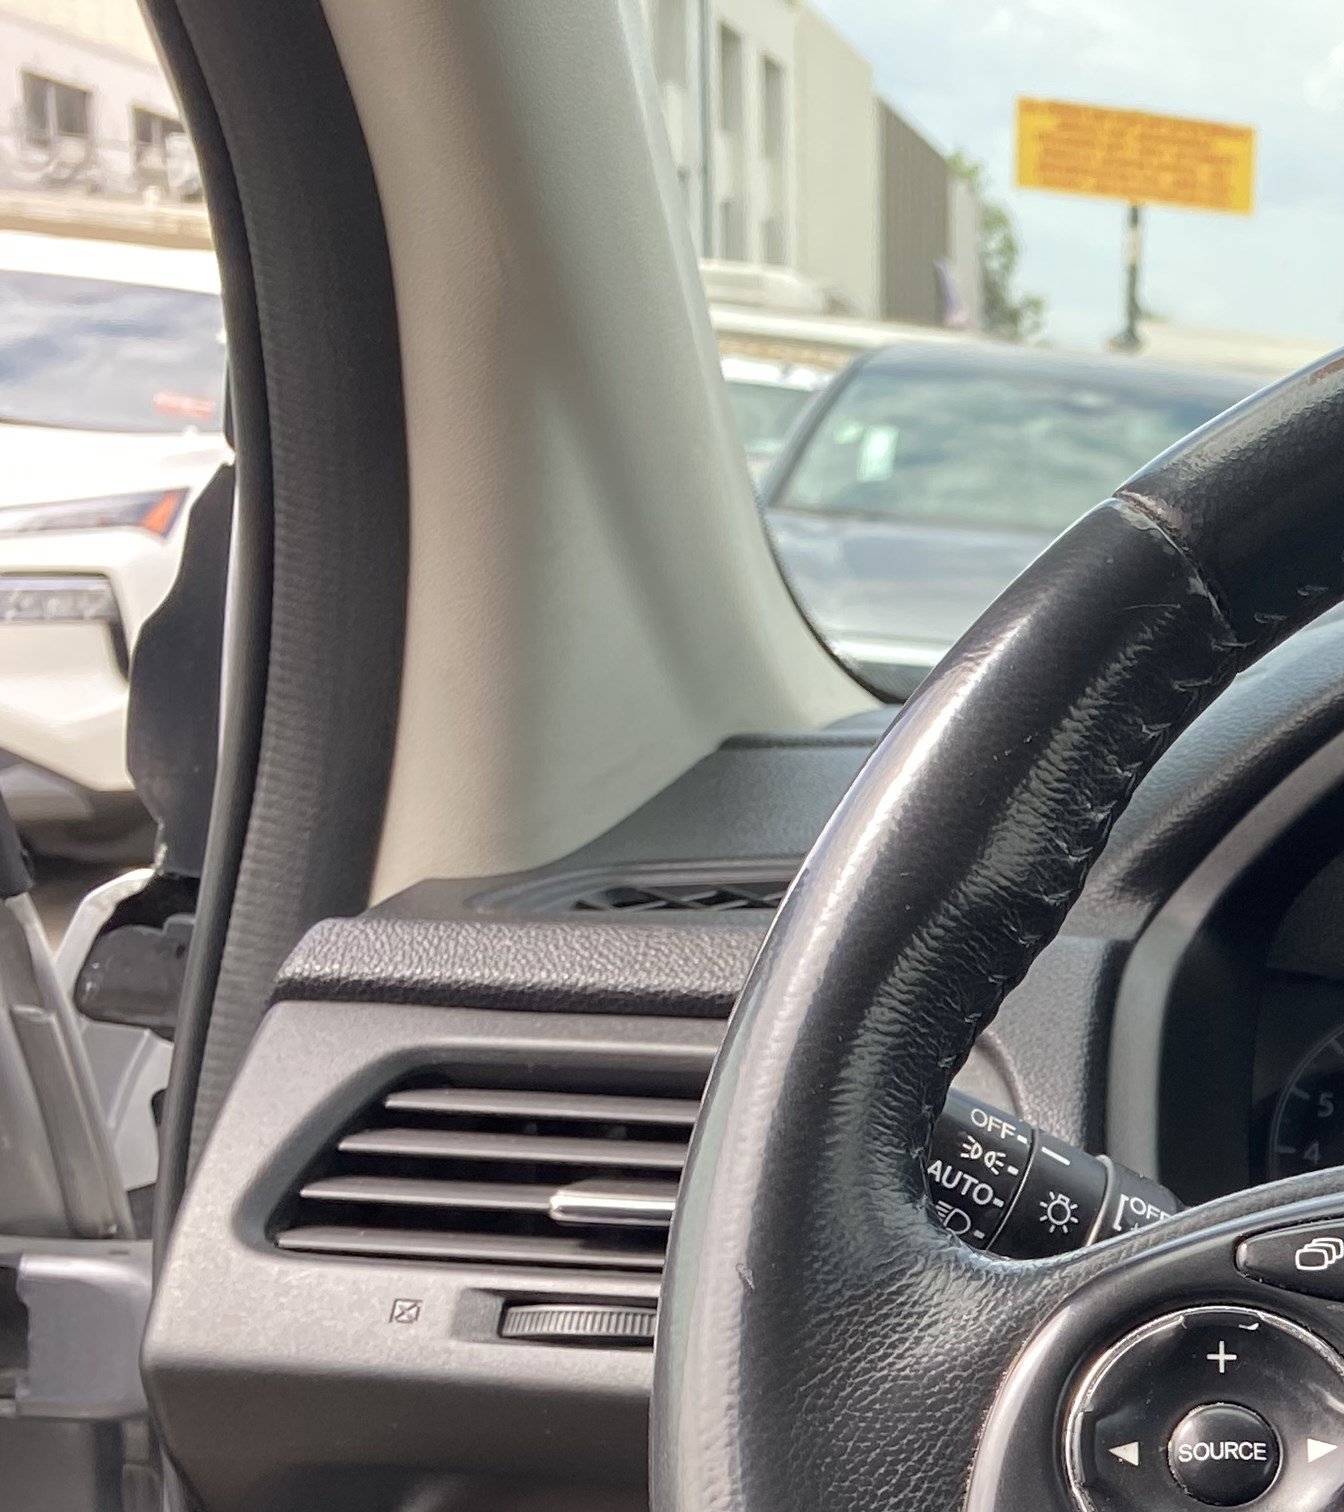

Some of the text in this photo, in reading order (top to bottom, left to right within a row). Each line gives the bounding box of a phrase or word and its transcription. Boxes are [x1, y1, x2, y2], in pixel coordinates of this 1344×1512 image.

[1317, 1093, 1335, 1119] 5
[970, 1107, 1017, 1140] OFF
[927, 1160, 994, 1206] AUTO
[1178, 1440, 1267, 1463] SOURCE
